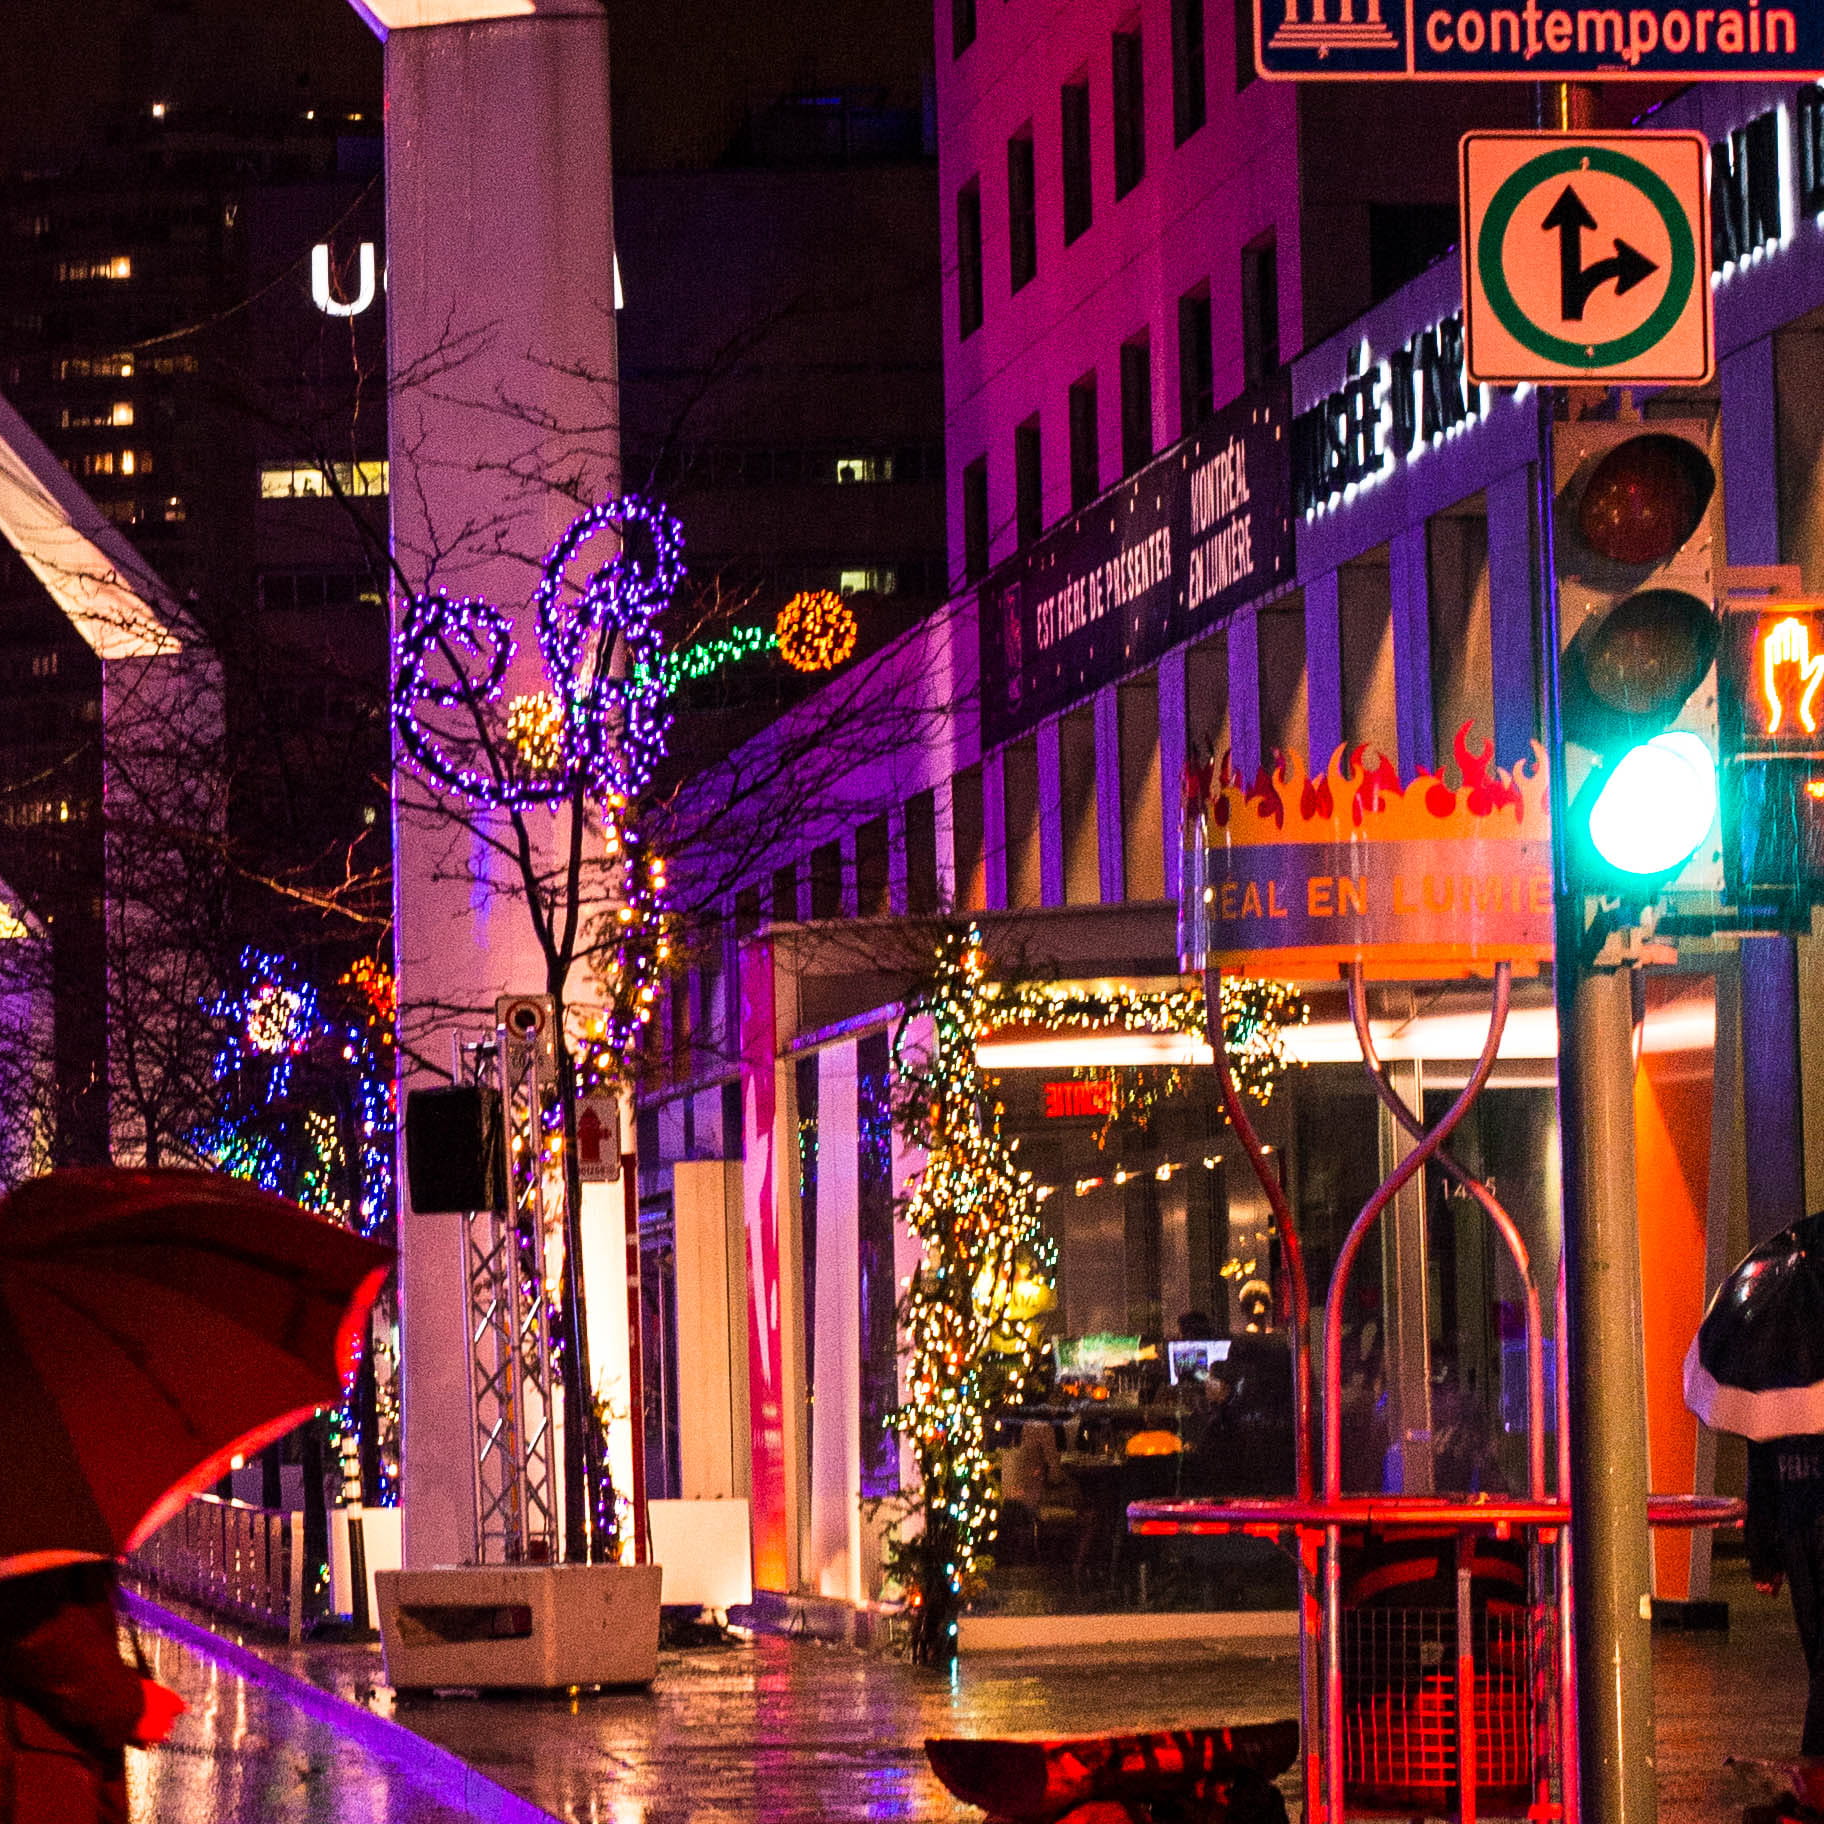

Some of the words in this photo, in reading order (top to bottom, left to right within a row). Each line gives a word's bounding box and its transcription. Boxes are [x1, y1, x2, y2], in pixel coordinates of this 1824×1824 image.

[1189, 433, 1251, 537] MONTRÉAL
[1035, 594, 1056, 651] EST
[1057, 572, 1088, 641] FIÈRE
[1088, 565, 1104, 622] DE
[1104, 525, 1173, 613] PRÉSENTER
[1188, 544, 1205, 612] EN
[1205, 512, 1255, 602] LUMIÈRE
[1306, 875, 1369, 918] EN
